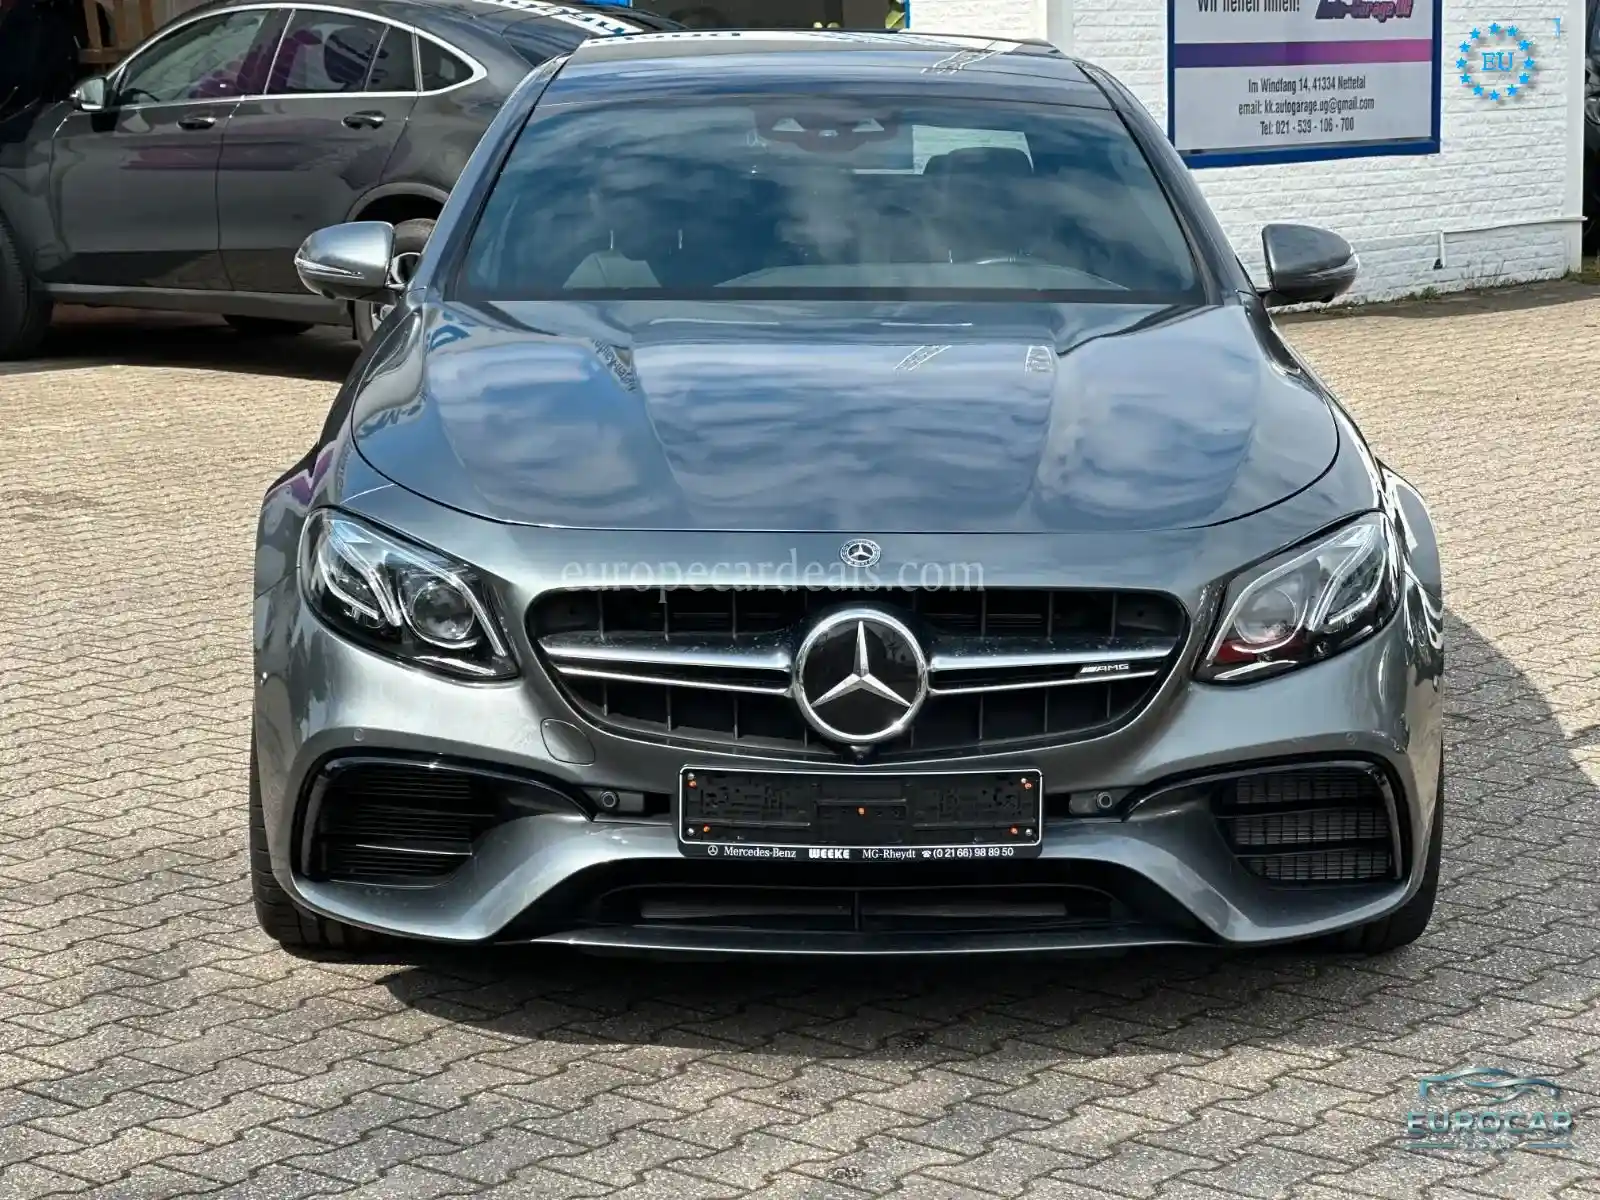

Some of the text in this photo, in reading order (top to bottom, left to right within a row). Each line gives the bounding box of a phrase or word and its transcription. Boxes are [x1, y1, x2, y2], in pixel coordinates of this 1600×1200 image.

[1248, 75, 1366, 95] Im Windfang 14, 41334 Nettetal
[1239, 96, 1375, 116] email: kk.autogarage.ug@gmail.com
[1260, 120, 1274, 135] Tel:
[1276, 120, 1290, 135] 021
[1319, 118, 1333, 133] 106
[1340, 117, 1354, 132] 700
[1096, 663, 1129, 672] AMG
[723, 845, 797, 858] Mercedes-Benz
[808, 848, 850, 859] WEEKE
[862, 848, 916, 861] MG-Rheydt
[974, 847, 986, 857] 98
[988, 846, 1000, 857] 89
[1002, 846, 1014, 857] 50
